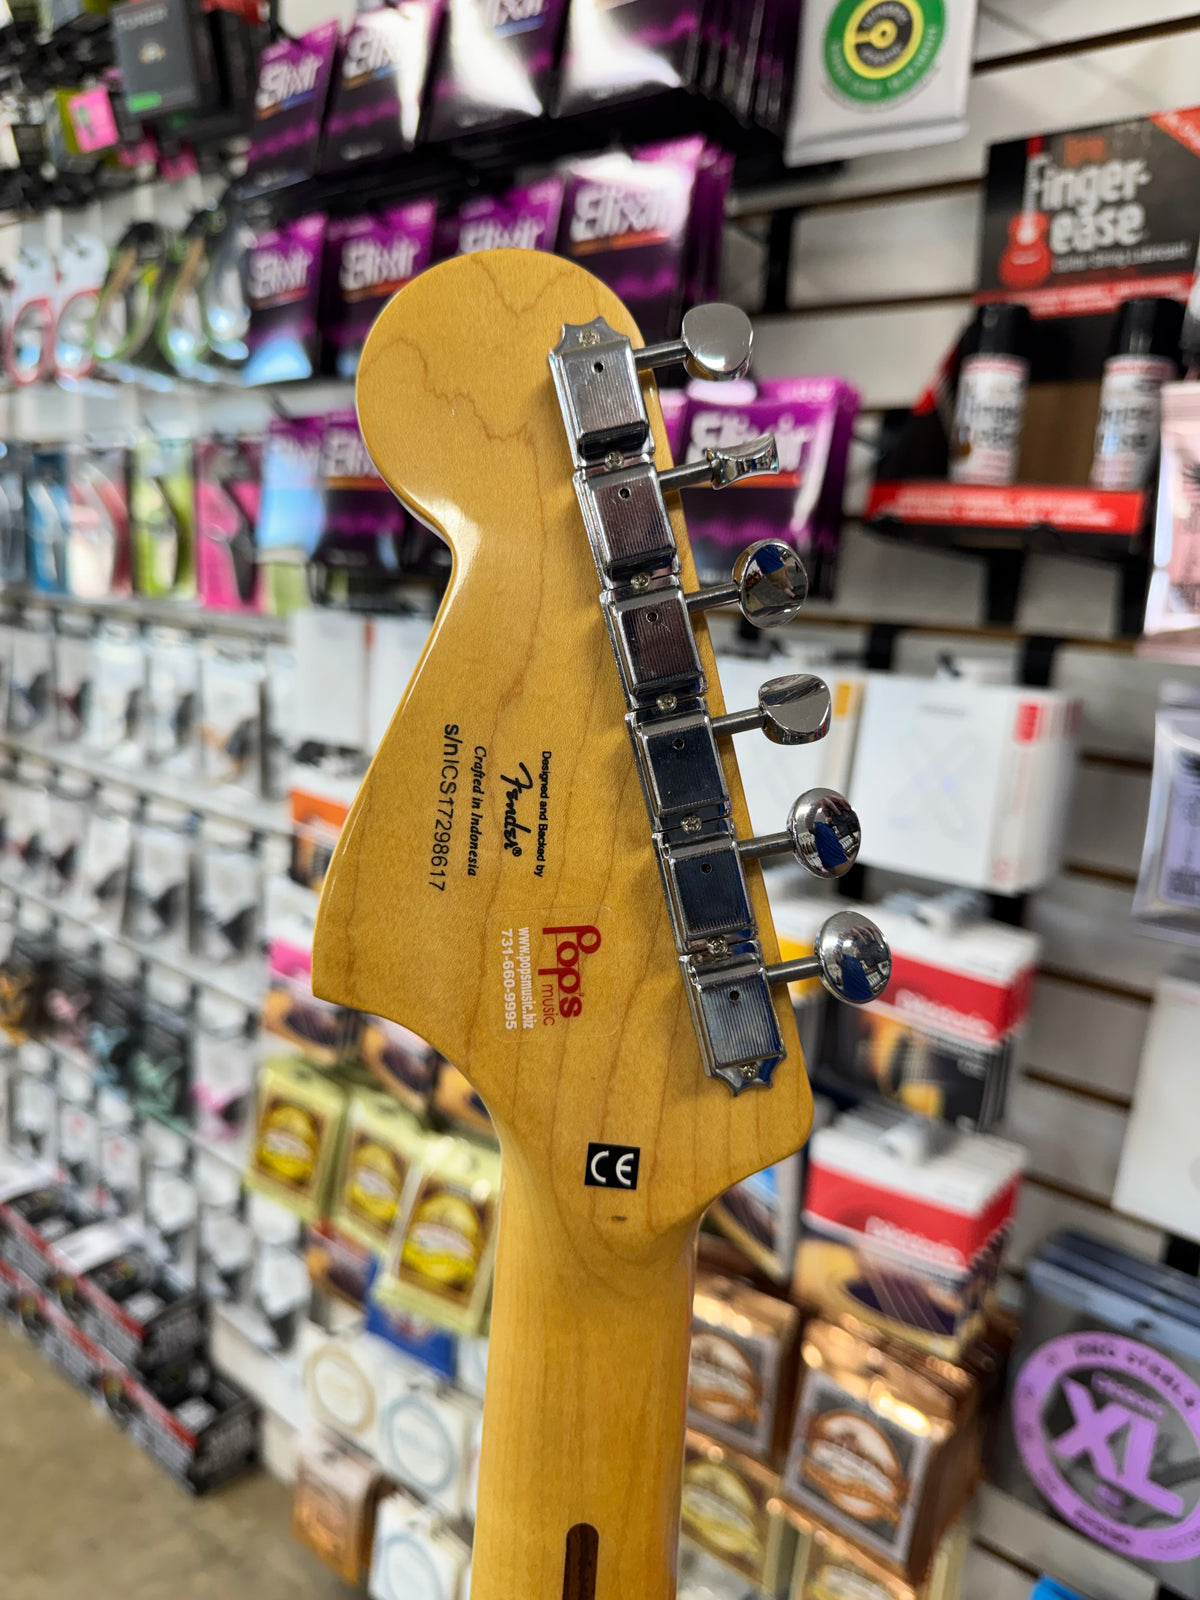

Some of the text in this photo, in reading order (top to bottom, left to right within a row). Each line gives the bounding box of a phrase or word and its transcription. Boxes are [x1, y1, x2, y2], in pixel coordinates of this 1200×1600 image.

[1051, 203, 1146, 254] ease
[467, 745, 487, 877] Crafted in Indonesia
[534, 750, 552, 878] Designed and Backed by
[501, 928, 517, 1030] 731-660-9995
[515, 926, 537, 1029] www.popsmusic.biz
[541, 984, 559, 1026] music
[590, 1150, 635, 1188] CE
[1053, 1374, 1184, 1518] XL
